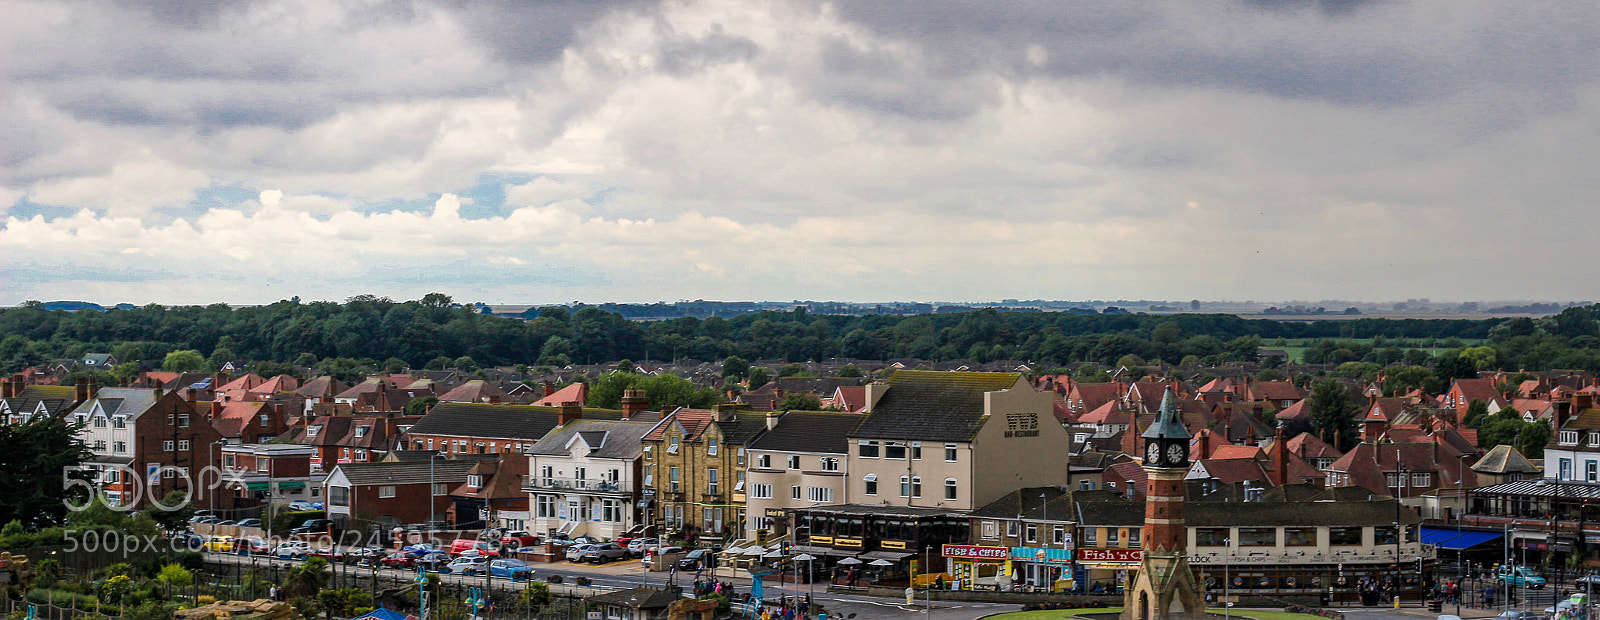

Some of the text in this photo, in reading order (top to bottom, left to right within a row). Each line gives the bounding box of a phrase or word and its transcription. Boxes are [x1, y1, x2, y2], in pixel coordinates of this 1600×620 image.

[945, 547, 1007, 557] FISH & CHIPS
[1083, 549, 1115, 560] Fish
